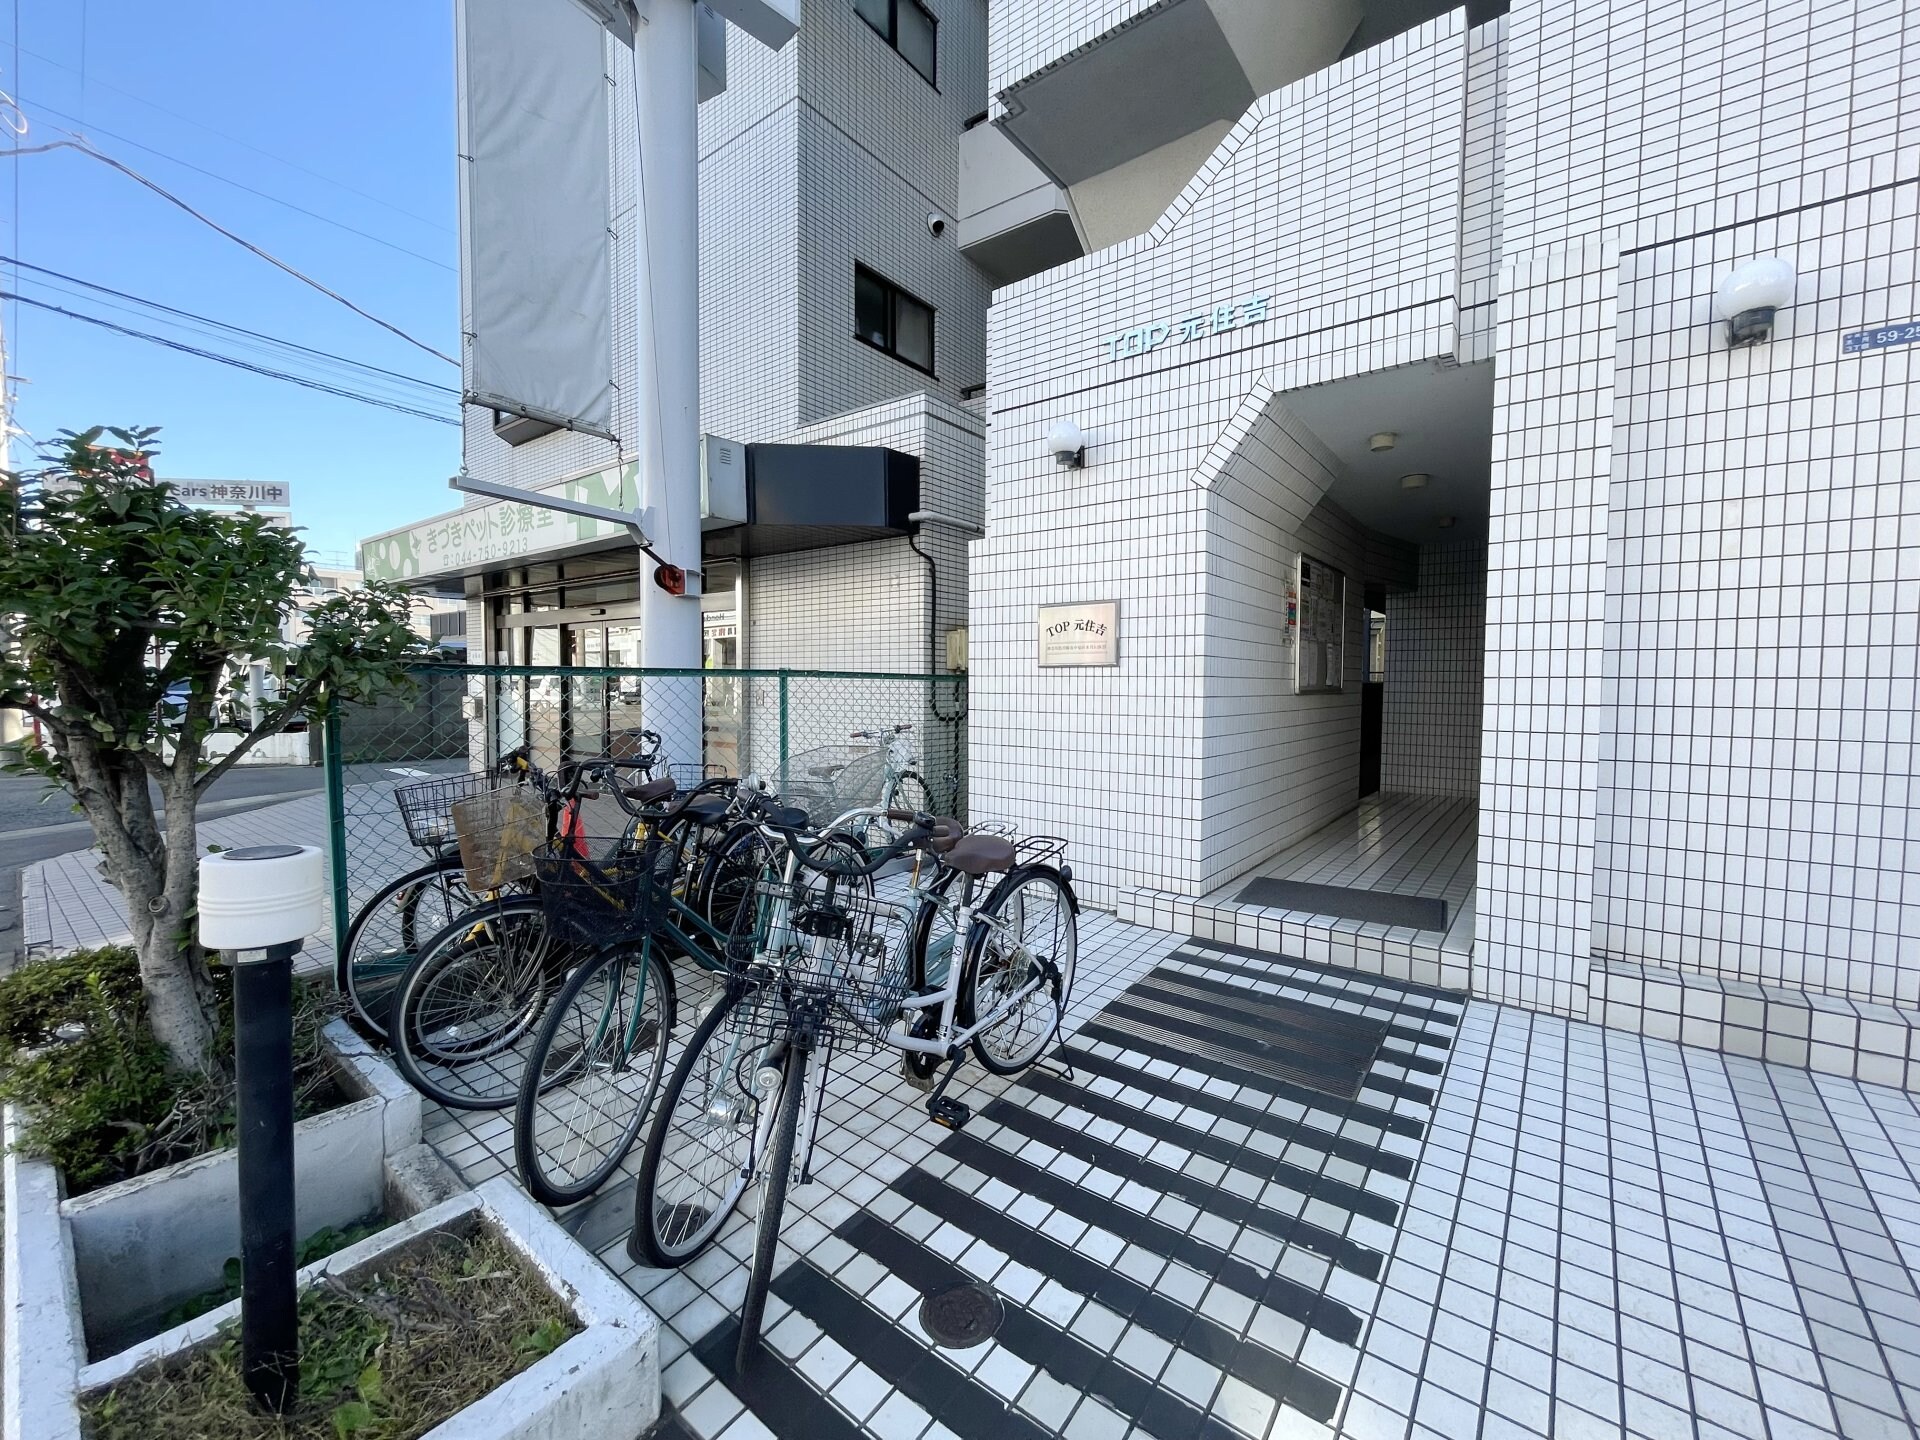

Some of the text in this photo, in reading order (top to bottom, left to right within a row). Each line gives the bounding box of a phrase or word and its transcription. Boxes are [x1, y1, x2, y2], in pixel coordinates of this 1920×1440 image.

[1103, 293, 1271, 362] TOP 元住吉
[210, 484, 283, 500] 神奈川中
[1046, 618, 1108, 638] TOP 元住吉
